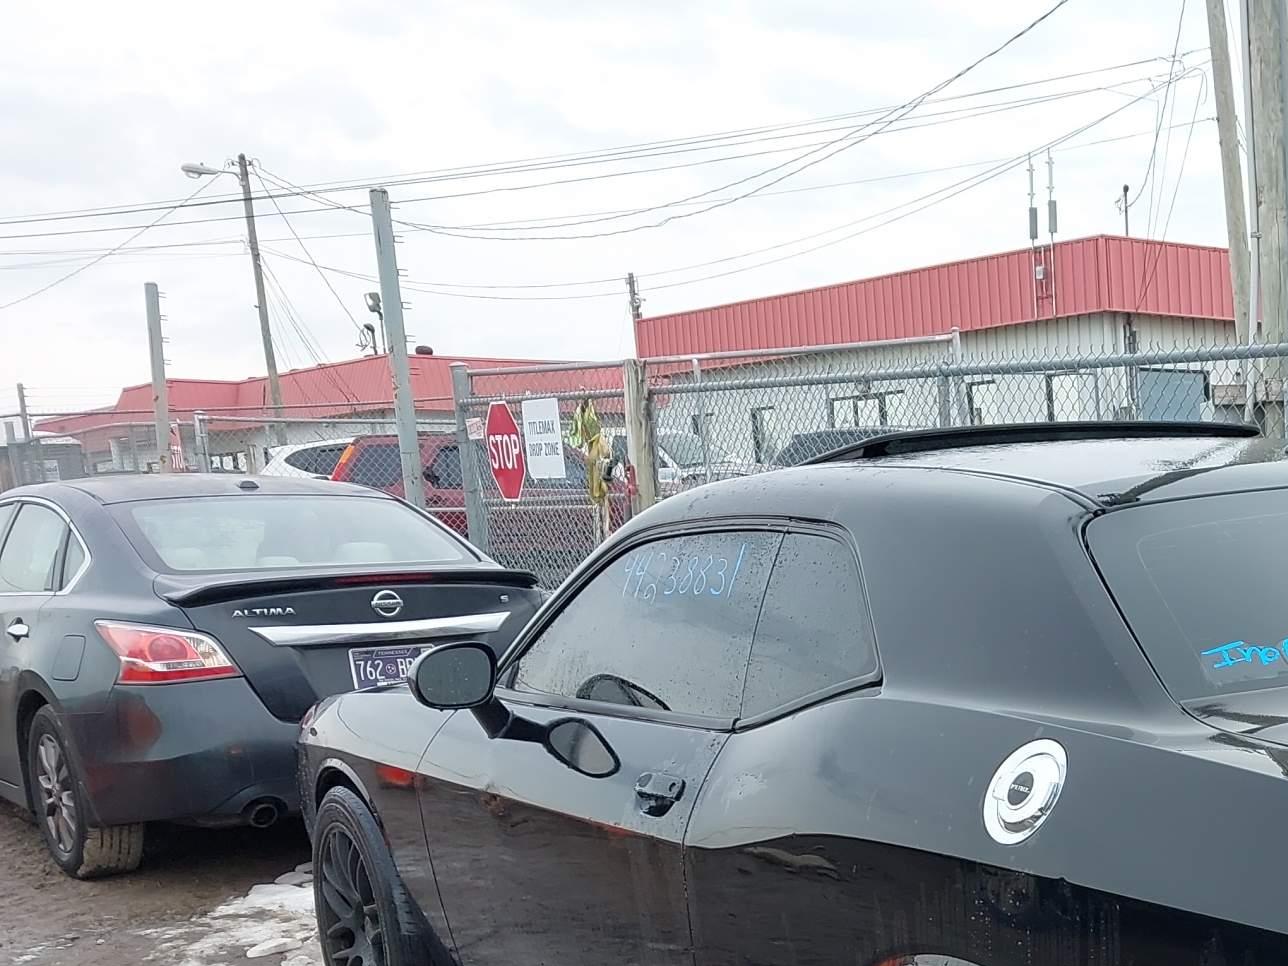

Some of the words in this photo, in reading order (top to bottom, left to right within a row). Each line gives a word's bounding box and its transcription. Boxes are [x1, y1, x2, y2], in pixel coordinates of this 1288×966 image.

[489, 434, 520, 469] STOP
[529, 442, 543, 457] DROP
[544, 441, 560, 456] ZONE
[500, 595, 509, 603] S
[231, 607, 297, 618] ALTIMA
[355, 660, 386, 680] 762
